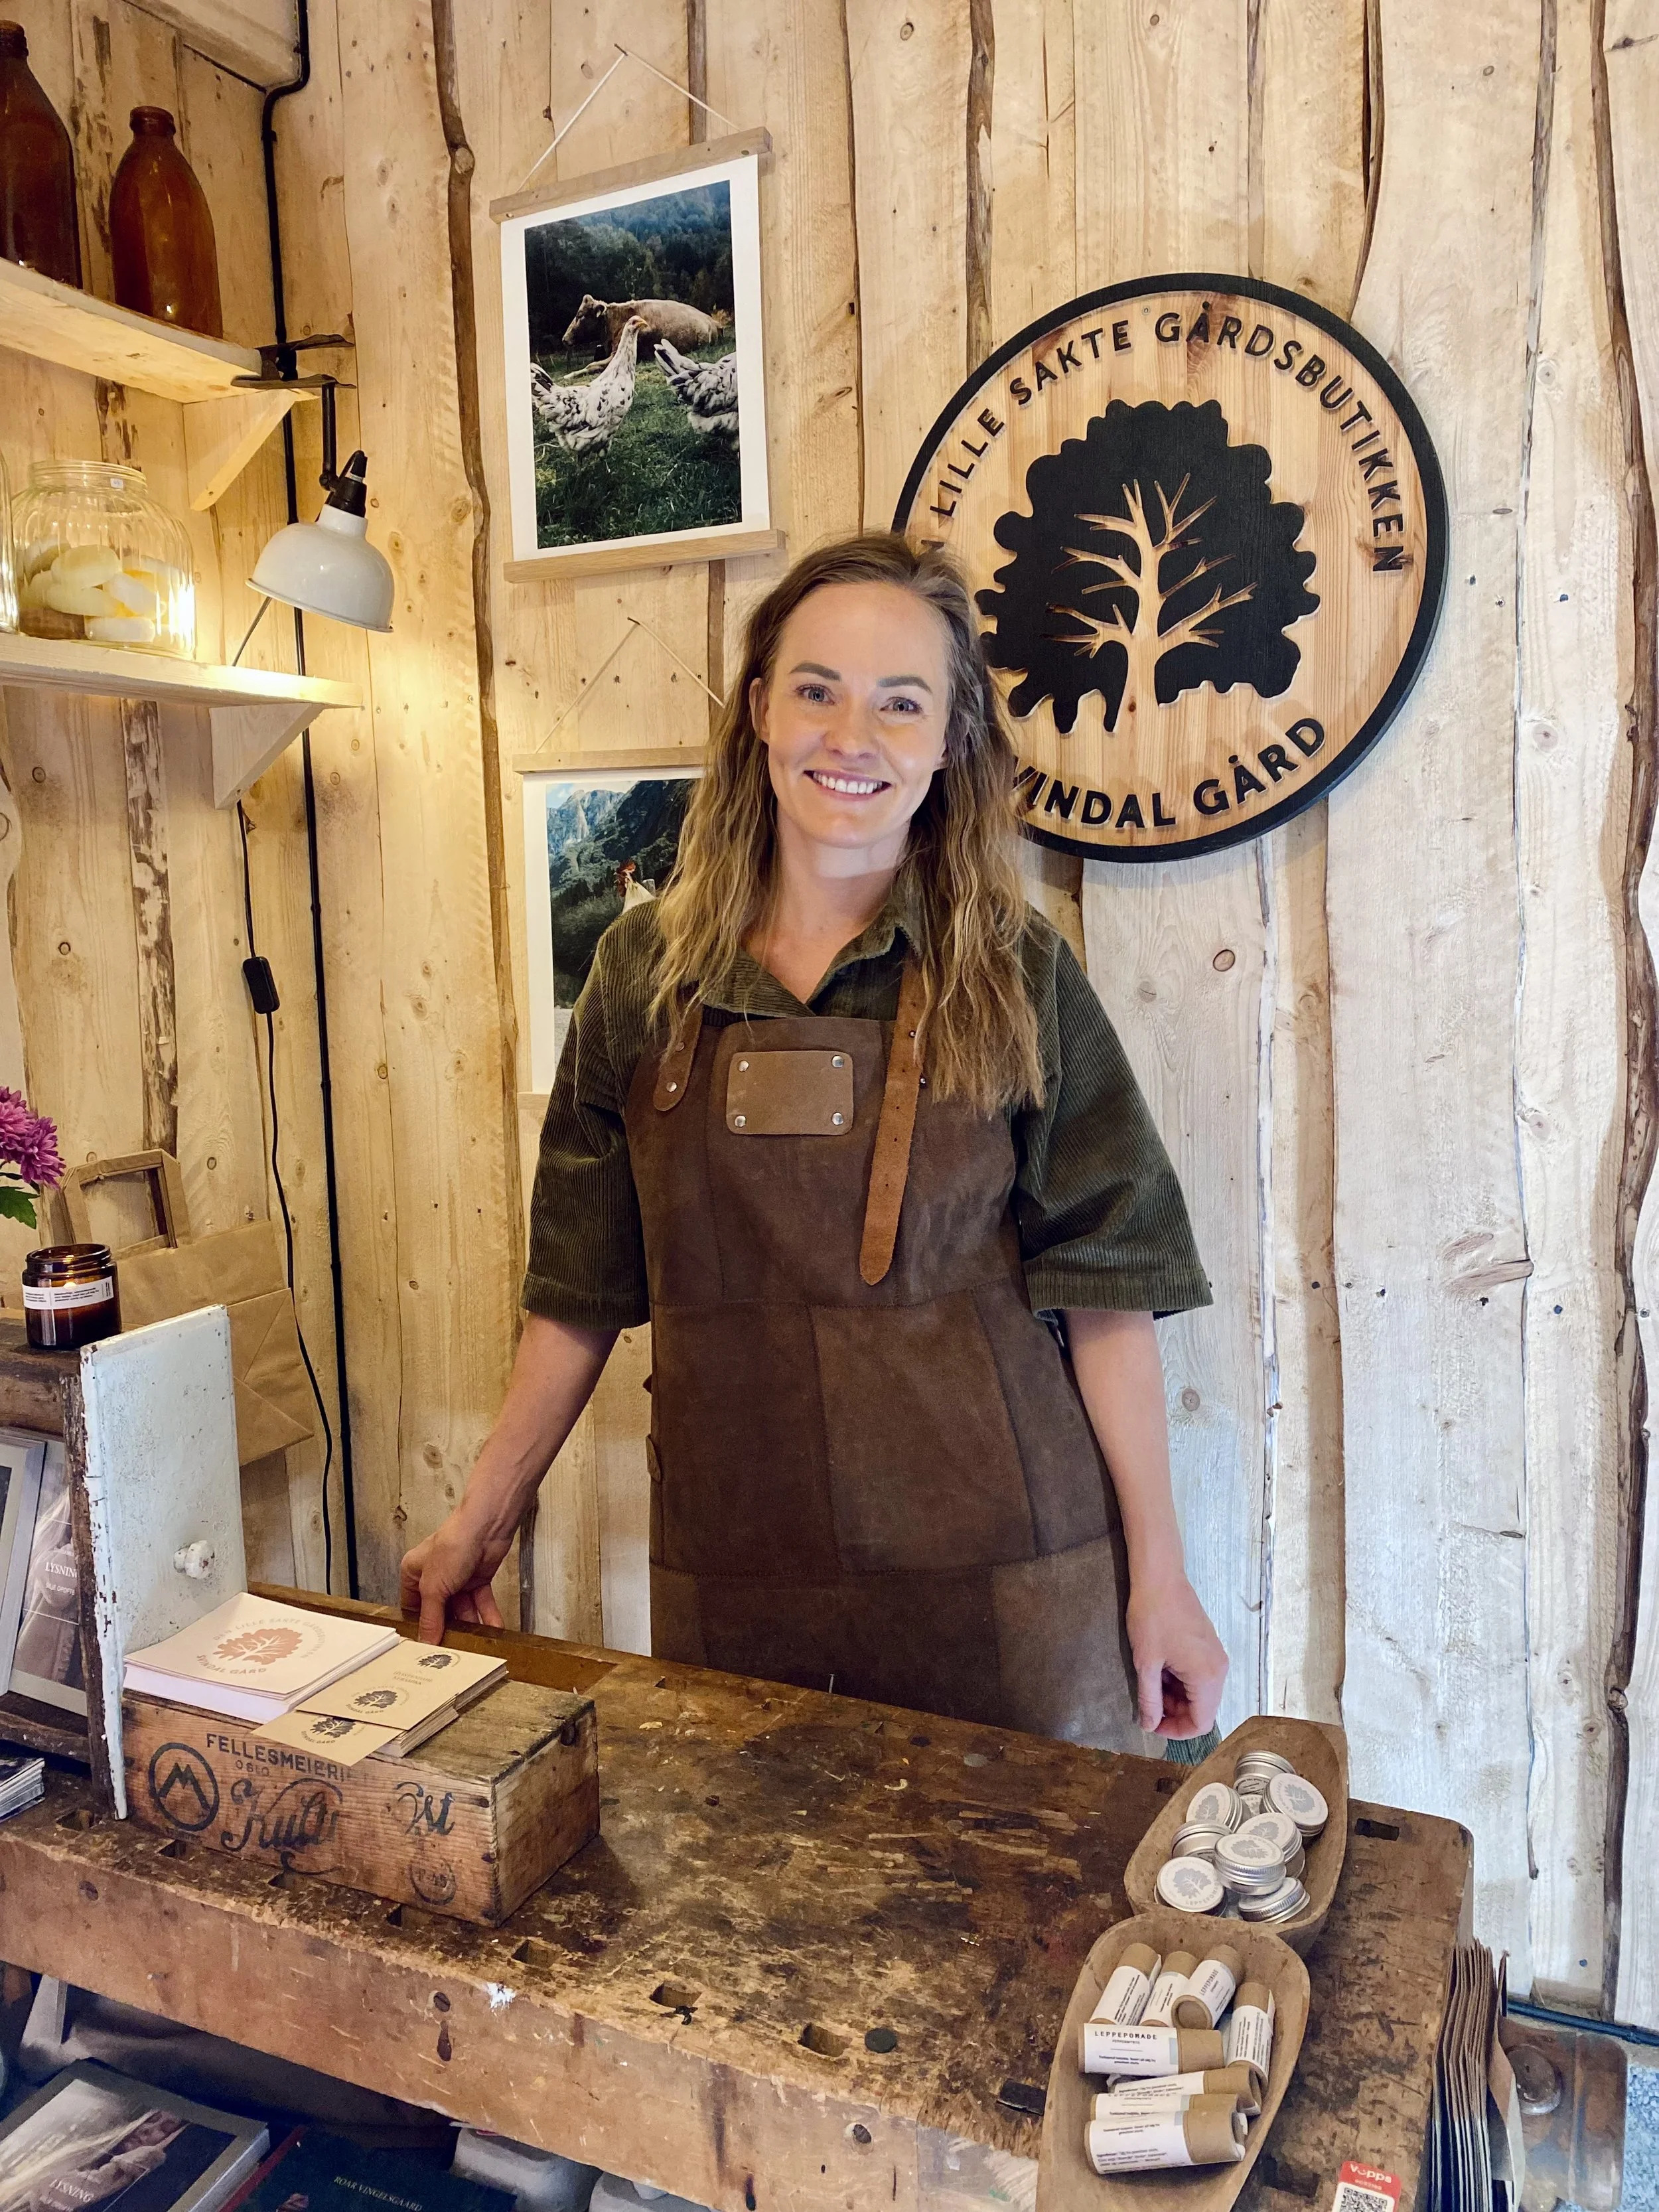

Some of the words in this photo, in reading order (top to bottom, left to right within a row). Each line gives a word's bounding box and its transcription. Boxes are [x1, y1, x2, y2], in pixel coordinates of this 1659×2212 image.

[930, 409, 1005, 517] LILLE
[1010, 319, 1132, 406] SAKTE
[1155, 301, 1404, 572] GÅRDSBUTIKKEN
[1013, 755, 1177, 829] VINDAL
[1193, 717, 1326, 816] GÅRD
[45, 1562, 78, 1578] LYSNIN
[1095, 2031, 1157, 2040] LEPPEPOMADE
[333, 2176, 358, 2190] ROAR
[358, 2184, 423, 2212] VINGELSGAARD
